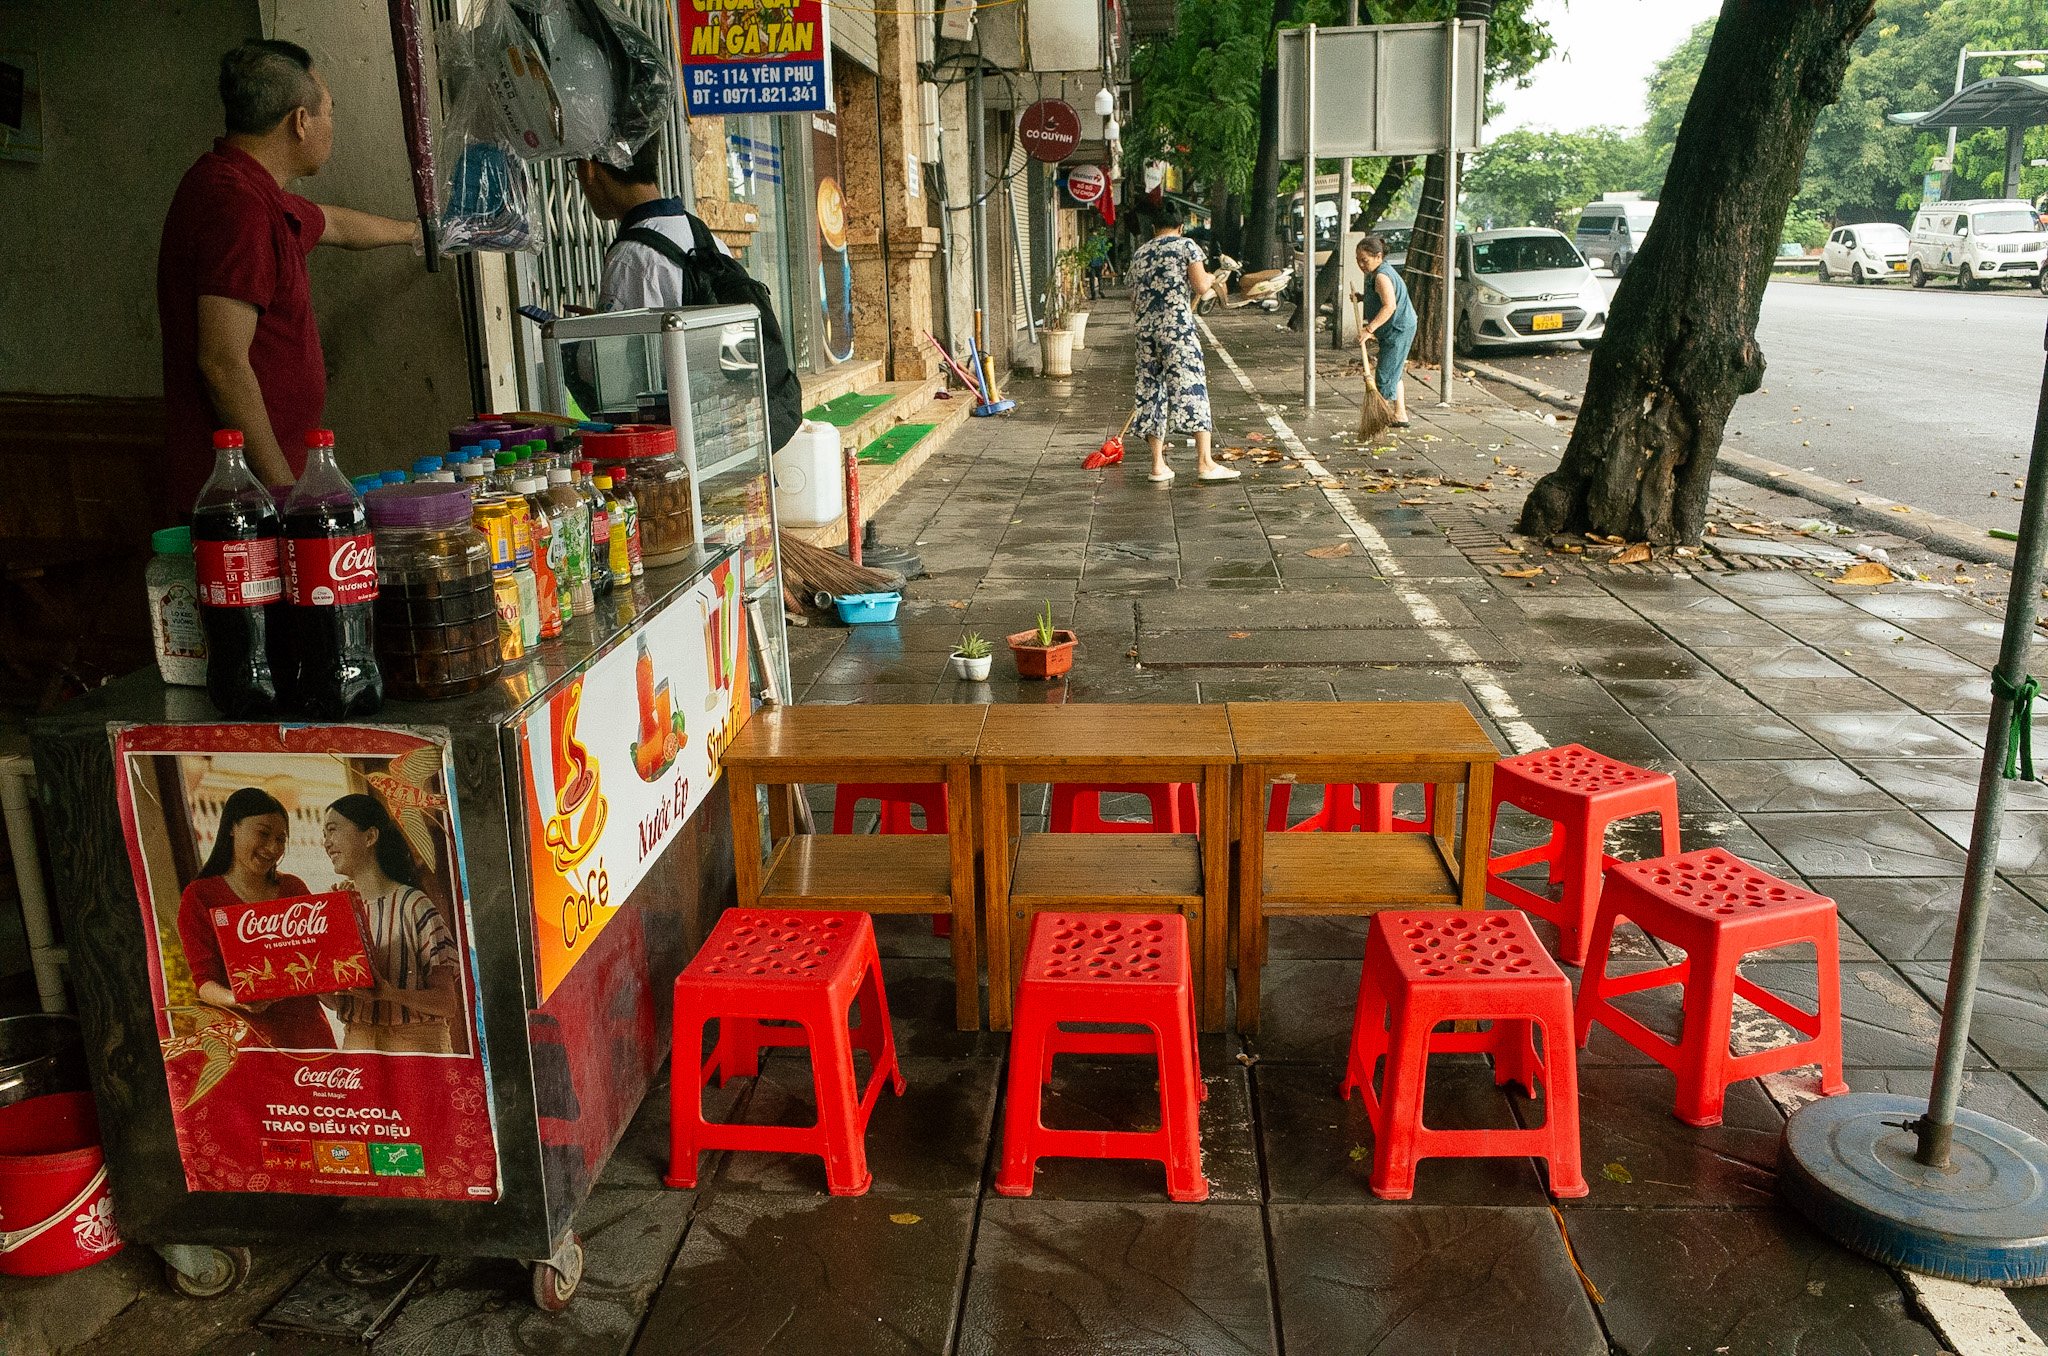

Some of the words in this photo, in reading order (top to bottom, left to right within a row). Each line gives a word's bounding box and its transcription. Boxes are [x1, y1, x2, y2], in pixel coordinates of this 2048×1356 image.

[726, 16, 761, 54] GÀ
[694, 69, 718, 86] ĐC:
[722, 68, 748, 84] 114
[752, 64, 780, 83] YÊN
[784, 66, 814, 85] PHỤ
[693, 89, 711, 105] ĐT
[723, 85, 817, 104] 0971.821.341
[329, 540, 378, 581] Coca
[337, 581, 368, 591] HƯƠNG
[638, 793, 671, 864] Nước
[674, 766, 689, 821] Ép
[562, 856, 609, 949] Café
[237, 900, 328, 943] Coca-Cola
[273, 940, 300, 948] NGUYÊN
[294, 1066, 364, 1090] Coca-Cola
[327, 1092, 347, 1100] Magic
[266, 1104, 310, 1116] TRAO
[313, 1106, 402, 1121] COCA-COLA
[262, 1120, 305, 1132] TRAO
[309, 1119, 346, 1134] ĐIỀU
[374, 1124, 411, 1139] DIỆU
